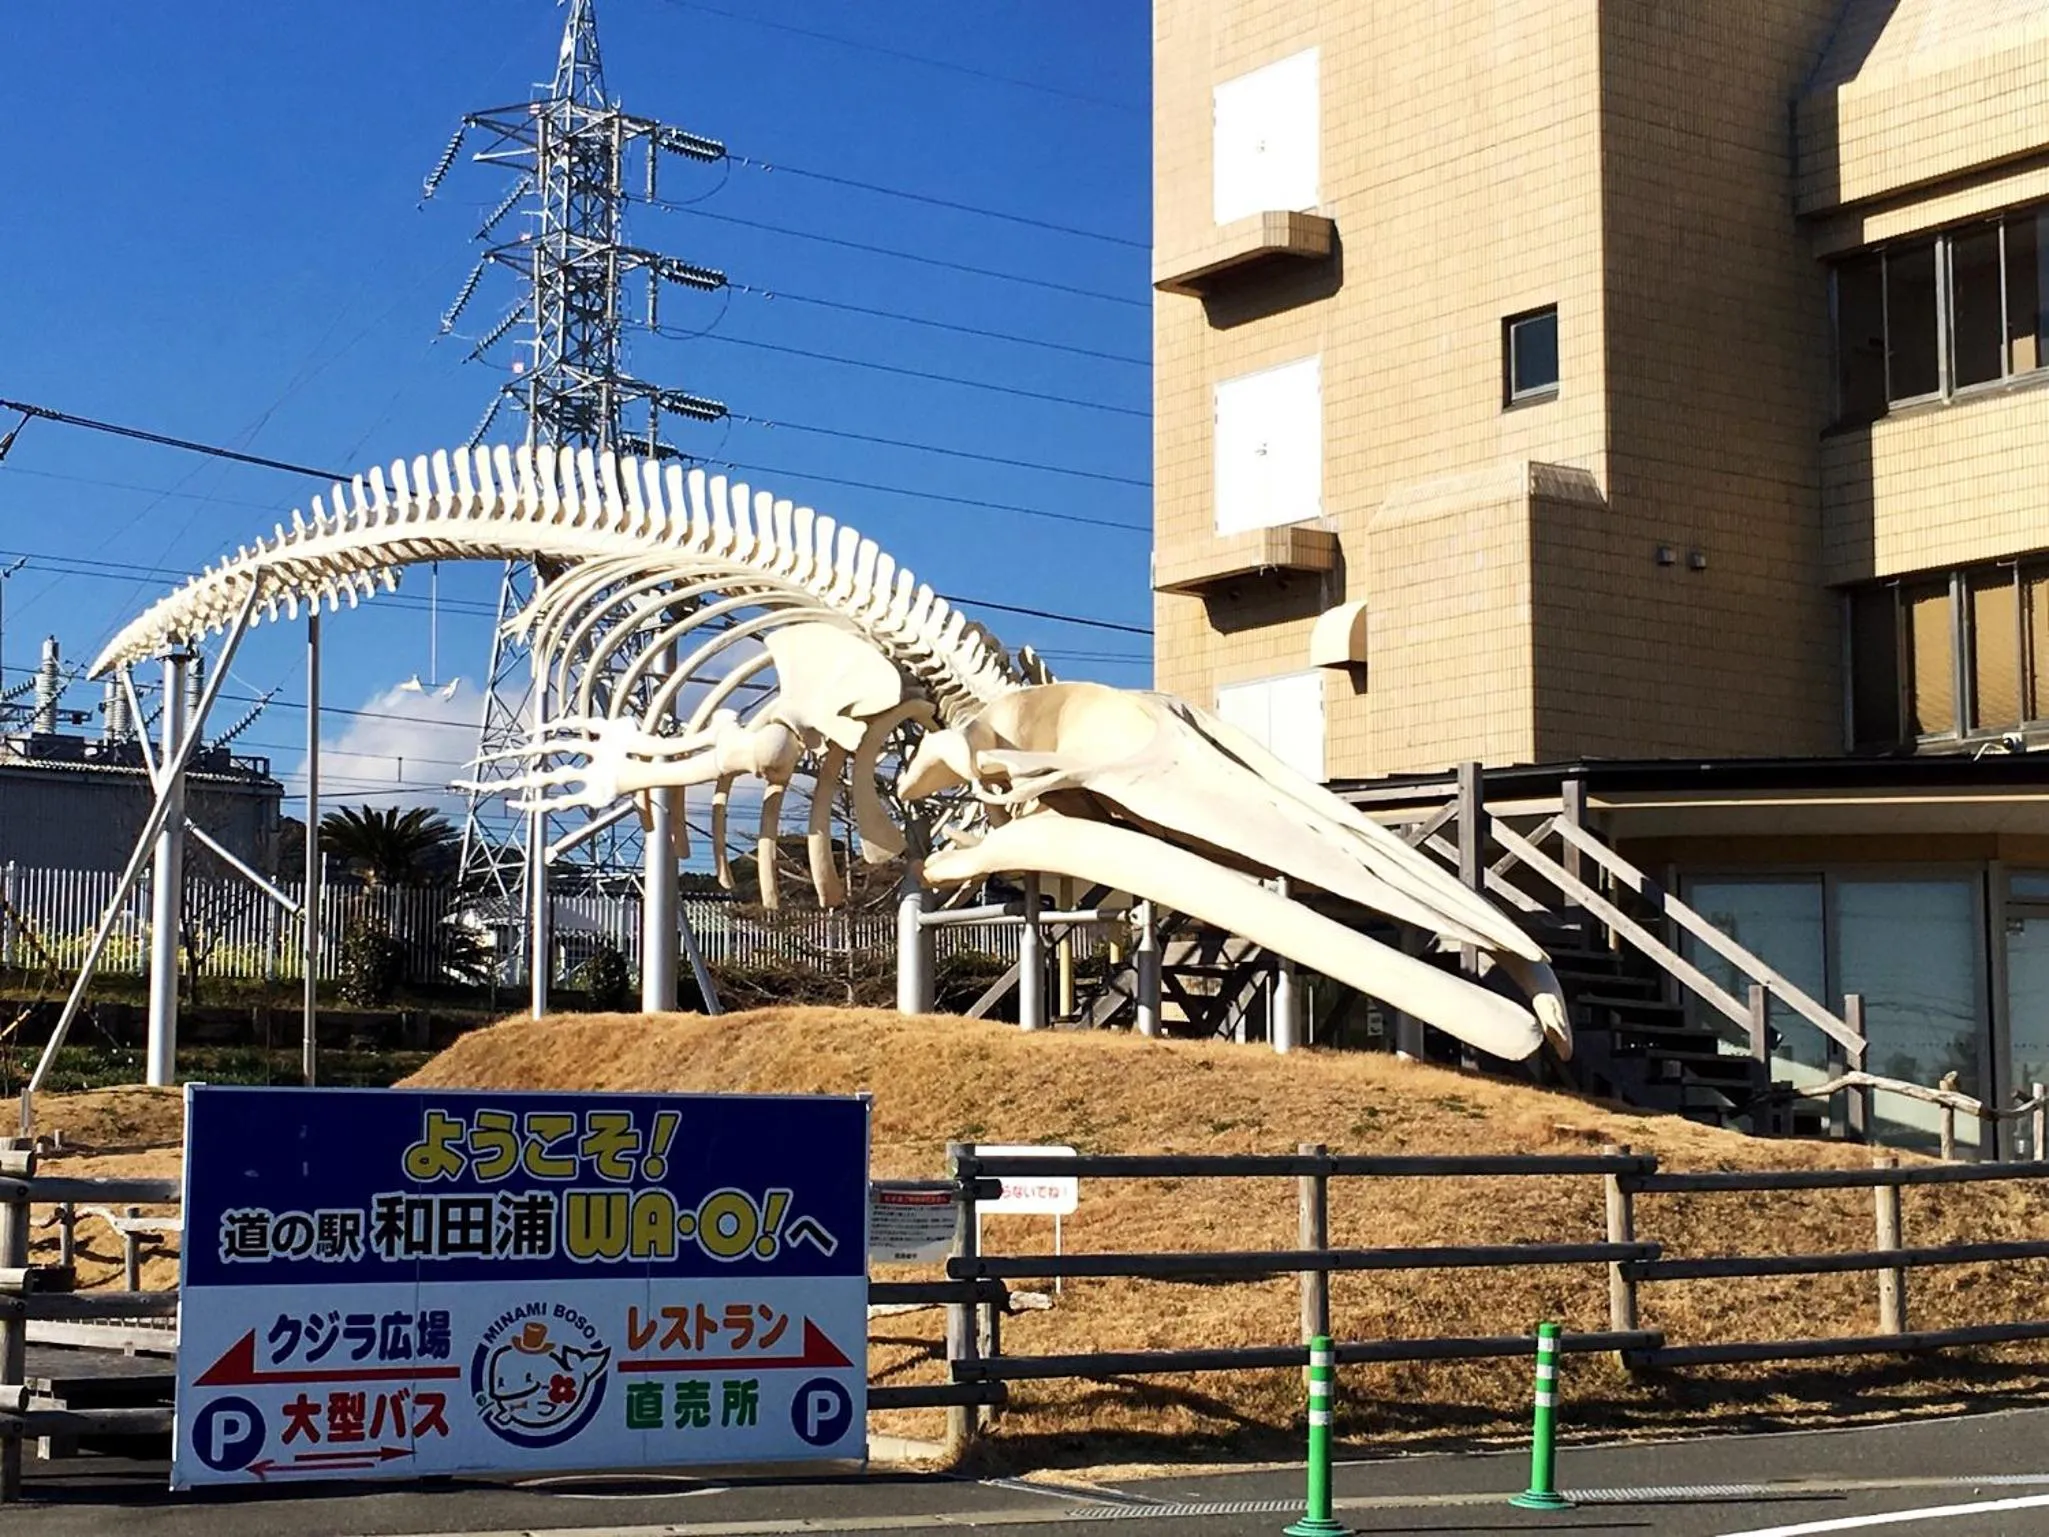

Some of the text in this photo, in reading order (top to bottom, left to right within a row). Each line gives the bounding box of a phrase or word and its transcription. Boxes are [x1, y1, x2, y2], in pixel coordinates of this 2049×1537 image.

[402, 1109, 681, 1182] ようこそ!
[268, 1310, 451, 1364] クジラ広場
[483, 1302, 596, 1344] MINAMI BOSO
[628, 1303, 789, 1351] レストラン
[281, 1387, 450, 1444] 大型バス
[626, 1379, 760, 1429] 直売所
[807, 1389, 851, 1437] P
[211, 1410, 252, 1462] P
